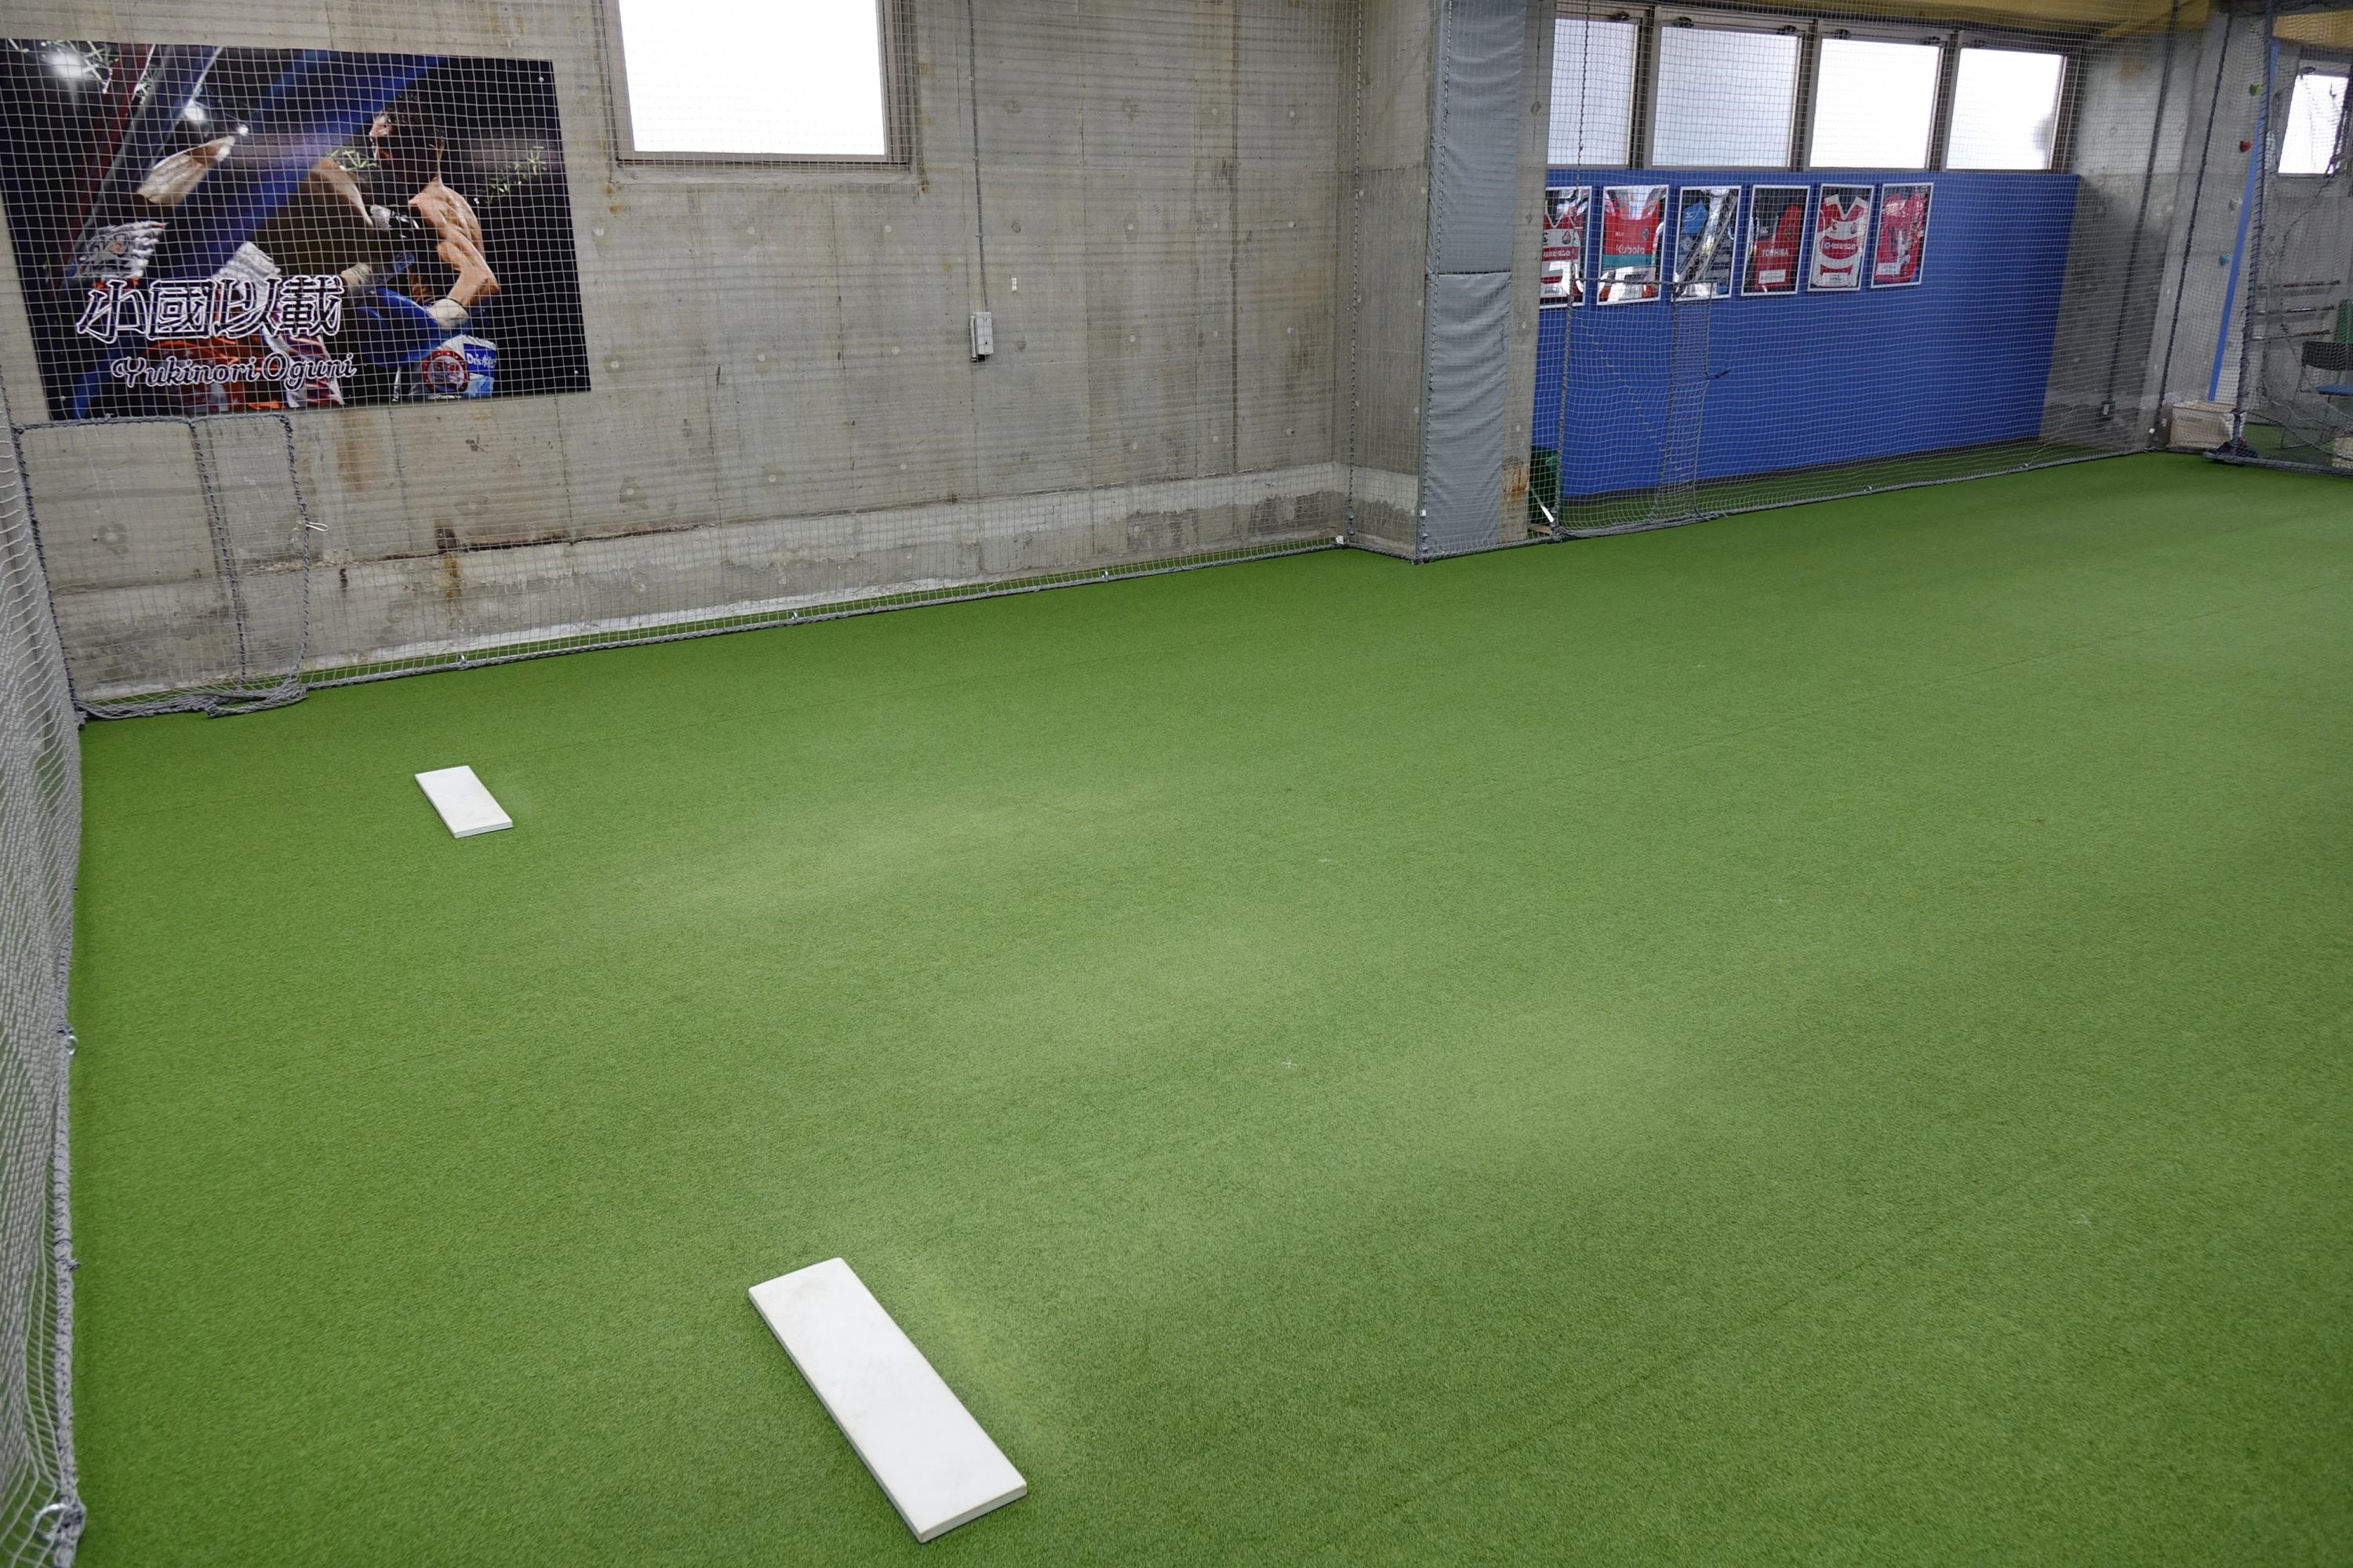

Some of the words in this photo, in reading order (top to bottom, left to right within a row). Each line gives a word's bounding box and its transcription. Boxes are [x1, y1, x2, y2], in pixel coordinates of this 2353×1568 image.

[1616, 244, 1645, 254] Kubota
[1762, 249, 1788, 257] TOSHIBA
[76, 275, 345, 344] 小國以載
[111, 353, 261, 387] Yukinori
[262, 351, 358, 391] Oguni
